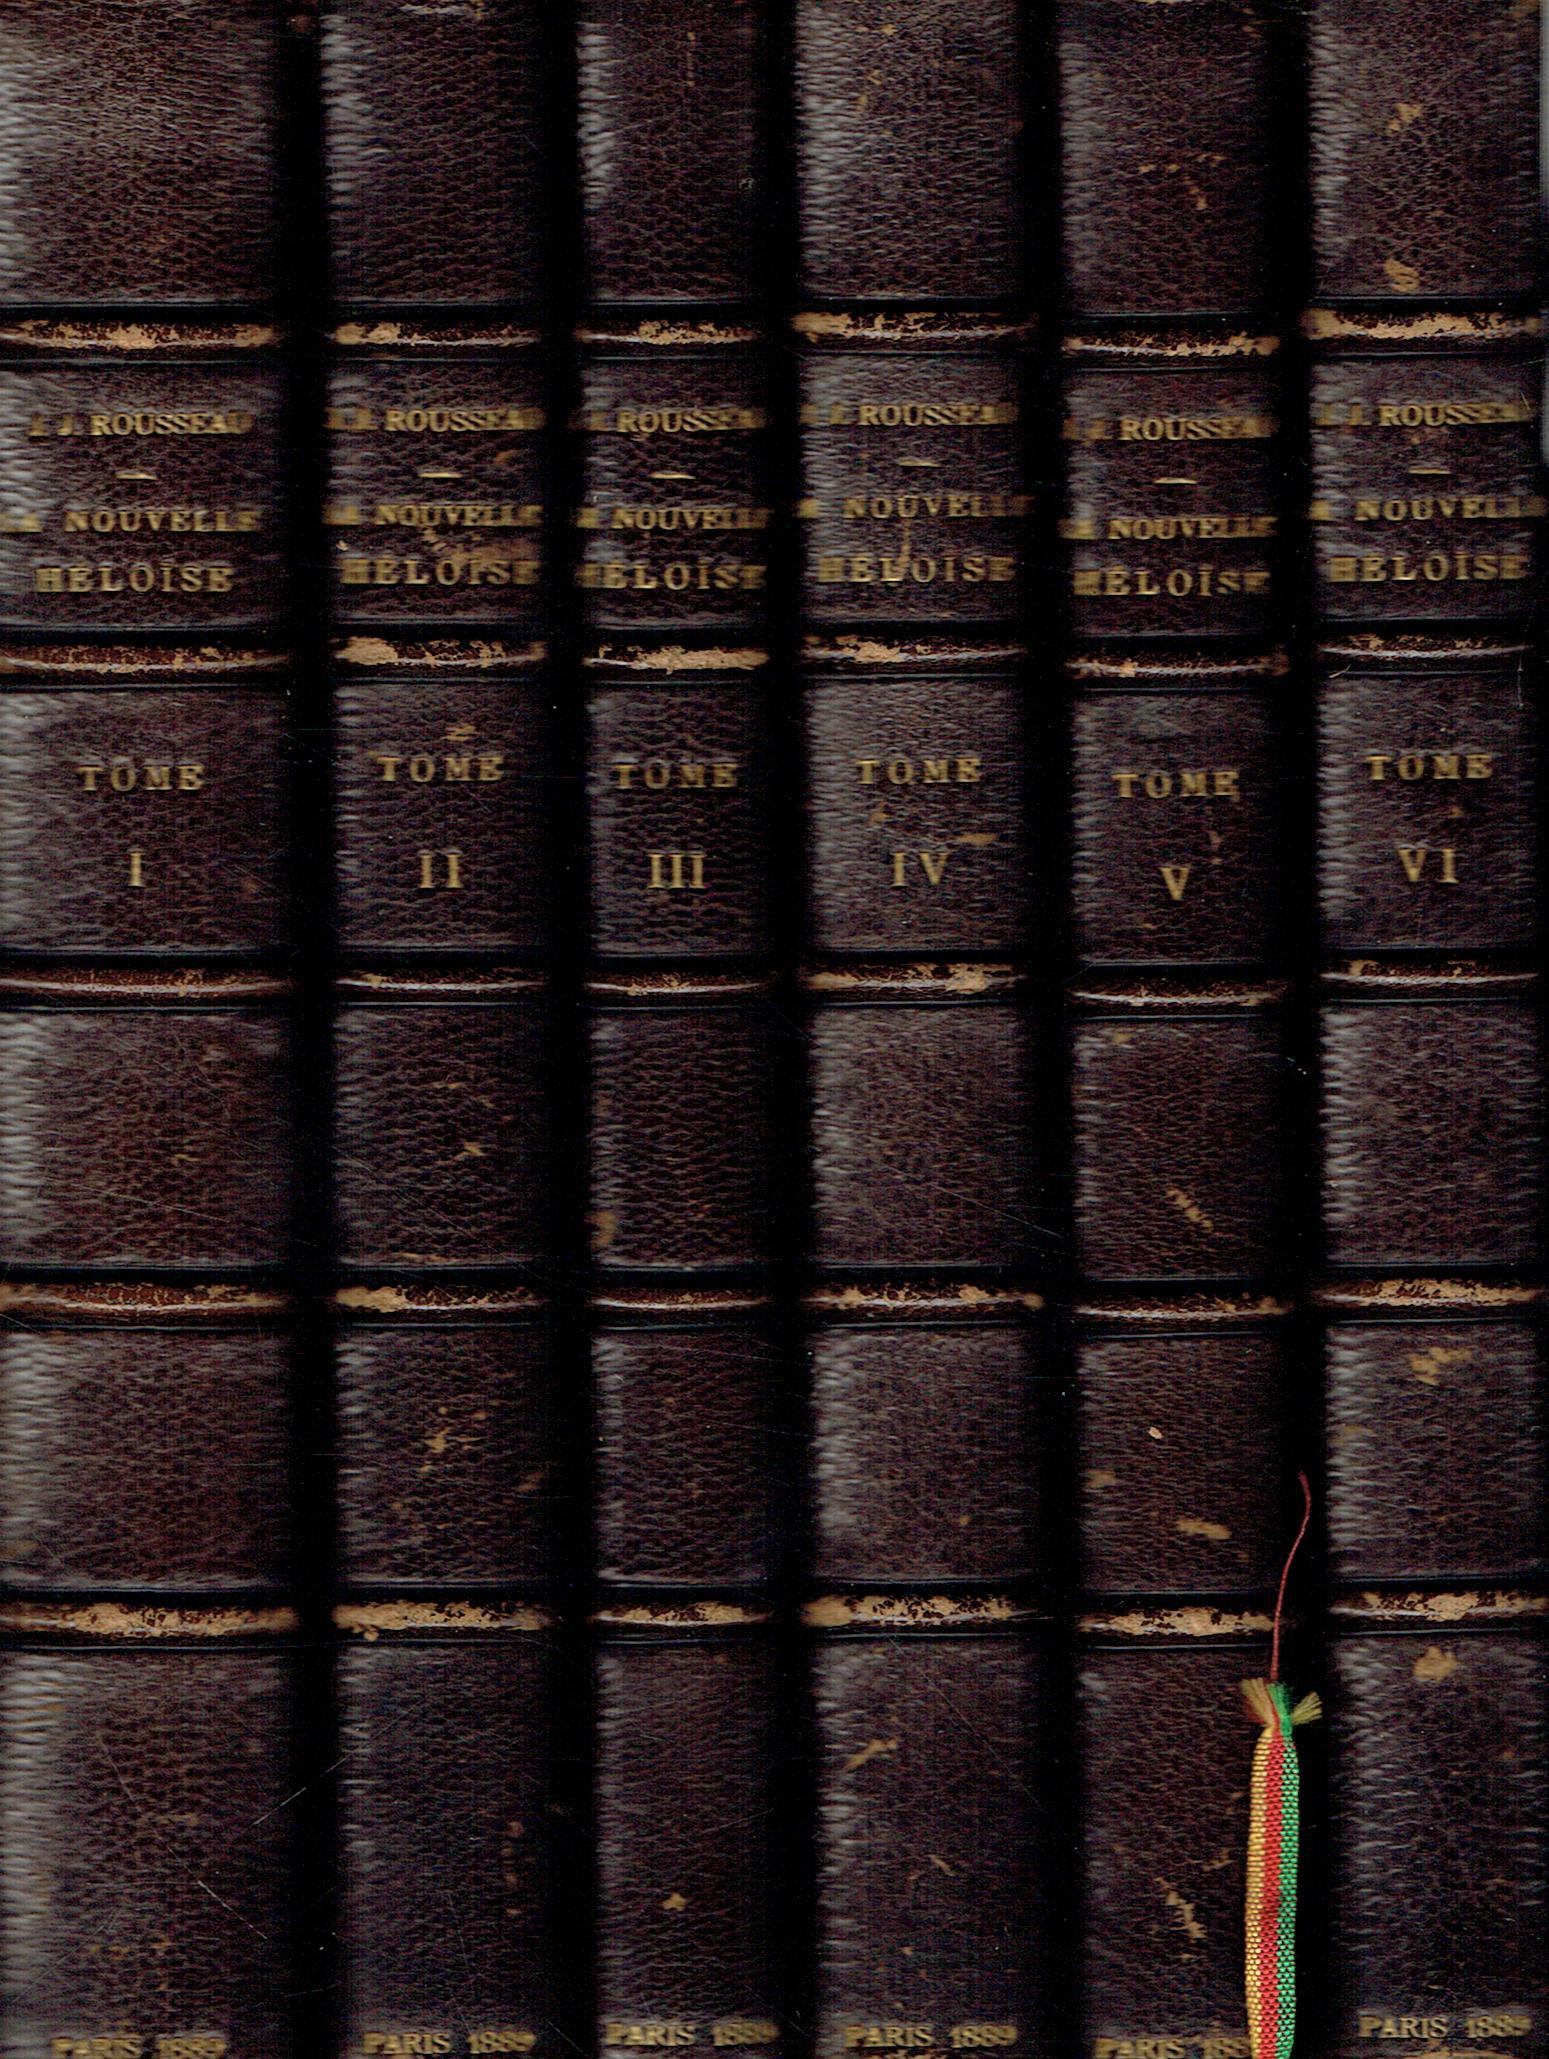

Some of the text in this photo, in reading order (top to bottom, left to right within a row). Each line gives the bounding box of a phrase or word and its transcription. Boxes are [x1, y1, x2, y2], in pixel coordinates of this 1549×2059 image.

[384, 410, 547, 432] ROUSSEA
[76, 765, 205, 791] TOME
[376, 756, 504, 782] TOME
[613, 763, 738, 789] TOME
[856, 757, 981, 785] TOME
[1366, 754, 1493, 781] TOME
[1111, 771, 1239, 798] TOME
[128, 852, 145, 887] I
[418, 853, 464, 888] II
[648, 853, 706, 889] III
[890, 851, 950, 887] IV
[1397, 848, 1459, 884] VI
[1159, 867, 1190, 900] V
[606, 2022, 696, 2046] PARIS
[844, 2025, 935, 2047] PARIS
[1359, 2016, 1449, 2039] PARIS
[363, 2032, 451, 2055] PARIS
[1202, 2036, 1250, 2059] 188
